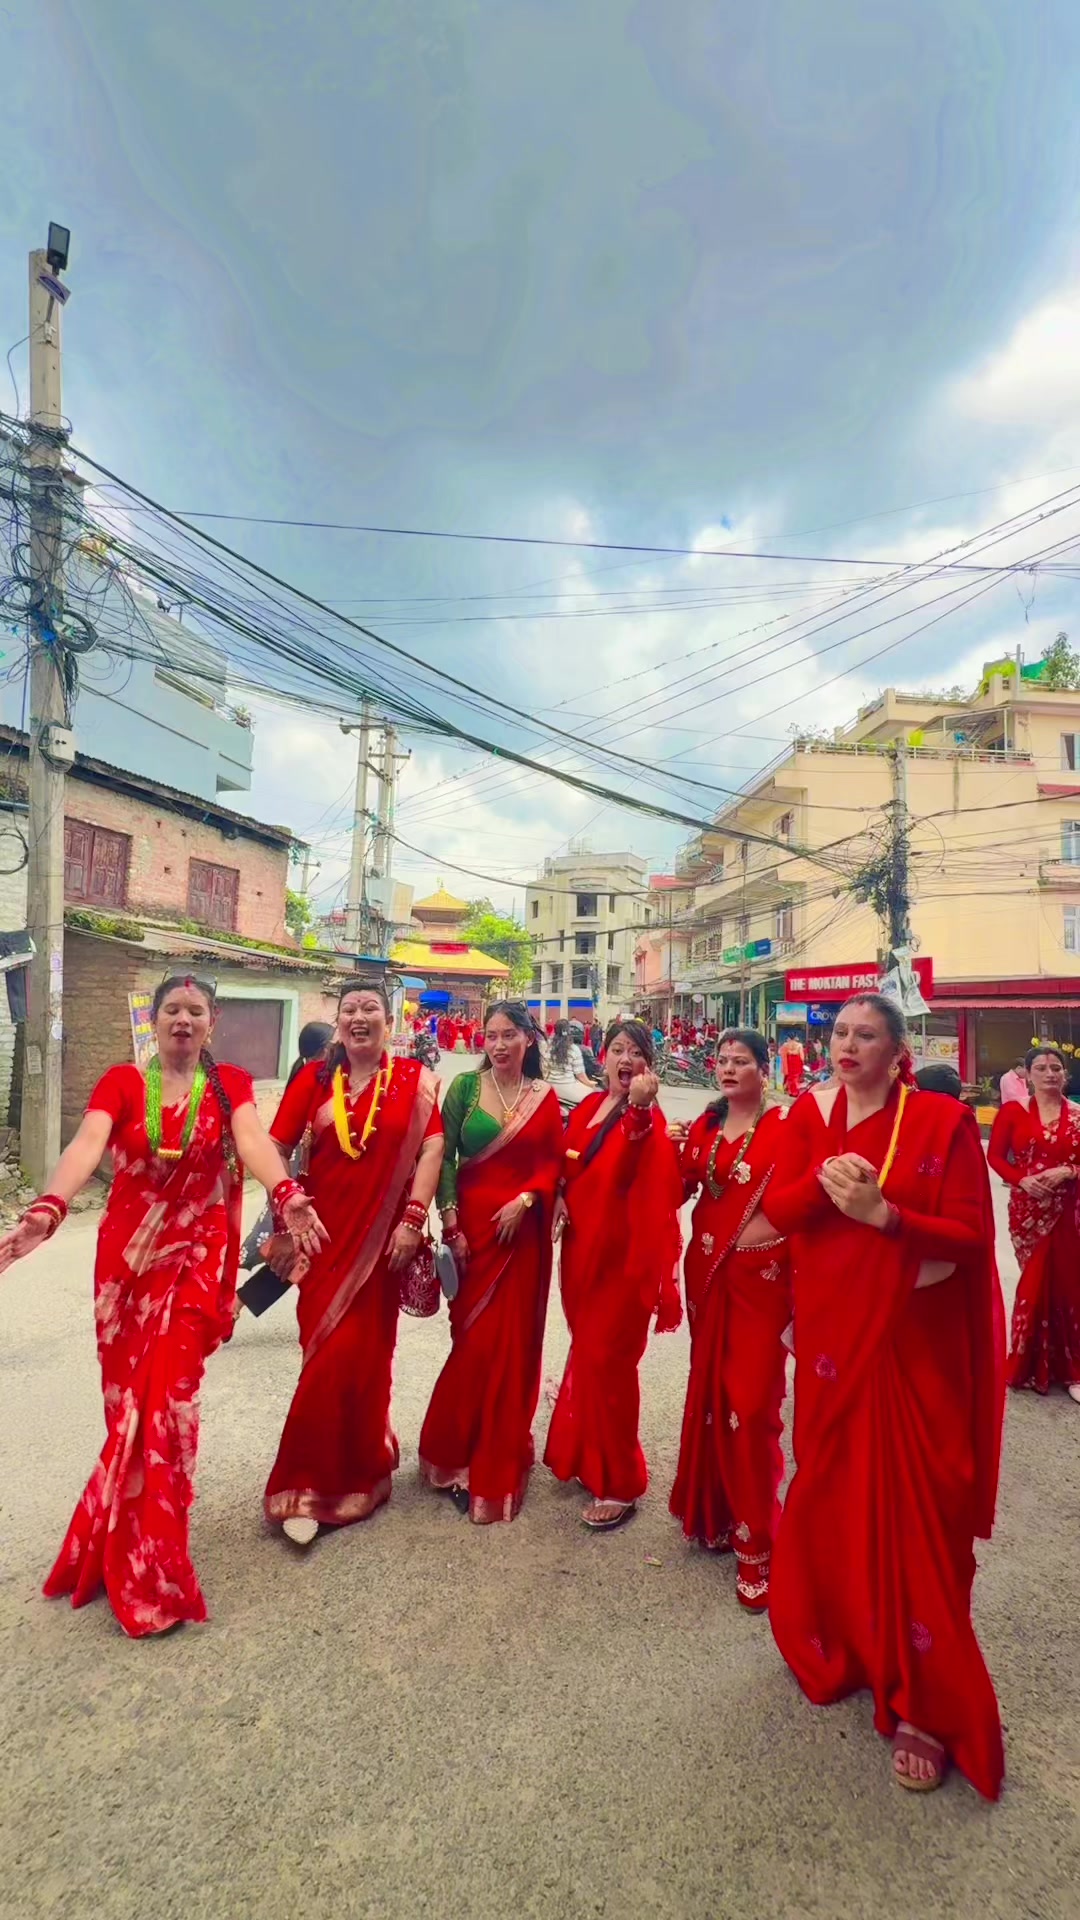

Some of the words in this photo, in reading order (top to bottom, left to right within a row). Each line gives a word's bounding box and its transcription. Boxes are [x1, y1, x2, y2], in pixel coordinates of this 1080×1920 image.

[789, 978, 807, 991] THE
[807, 975, 850, 990] MOKTAN
[852, 973, 879, 989] FAST
[810, 1009, 837, 1021] CROW
